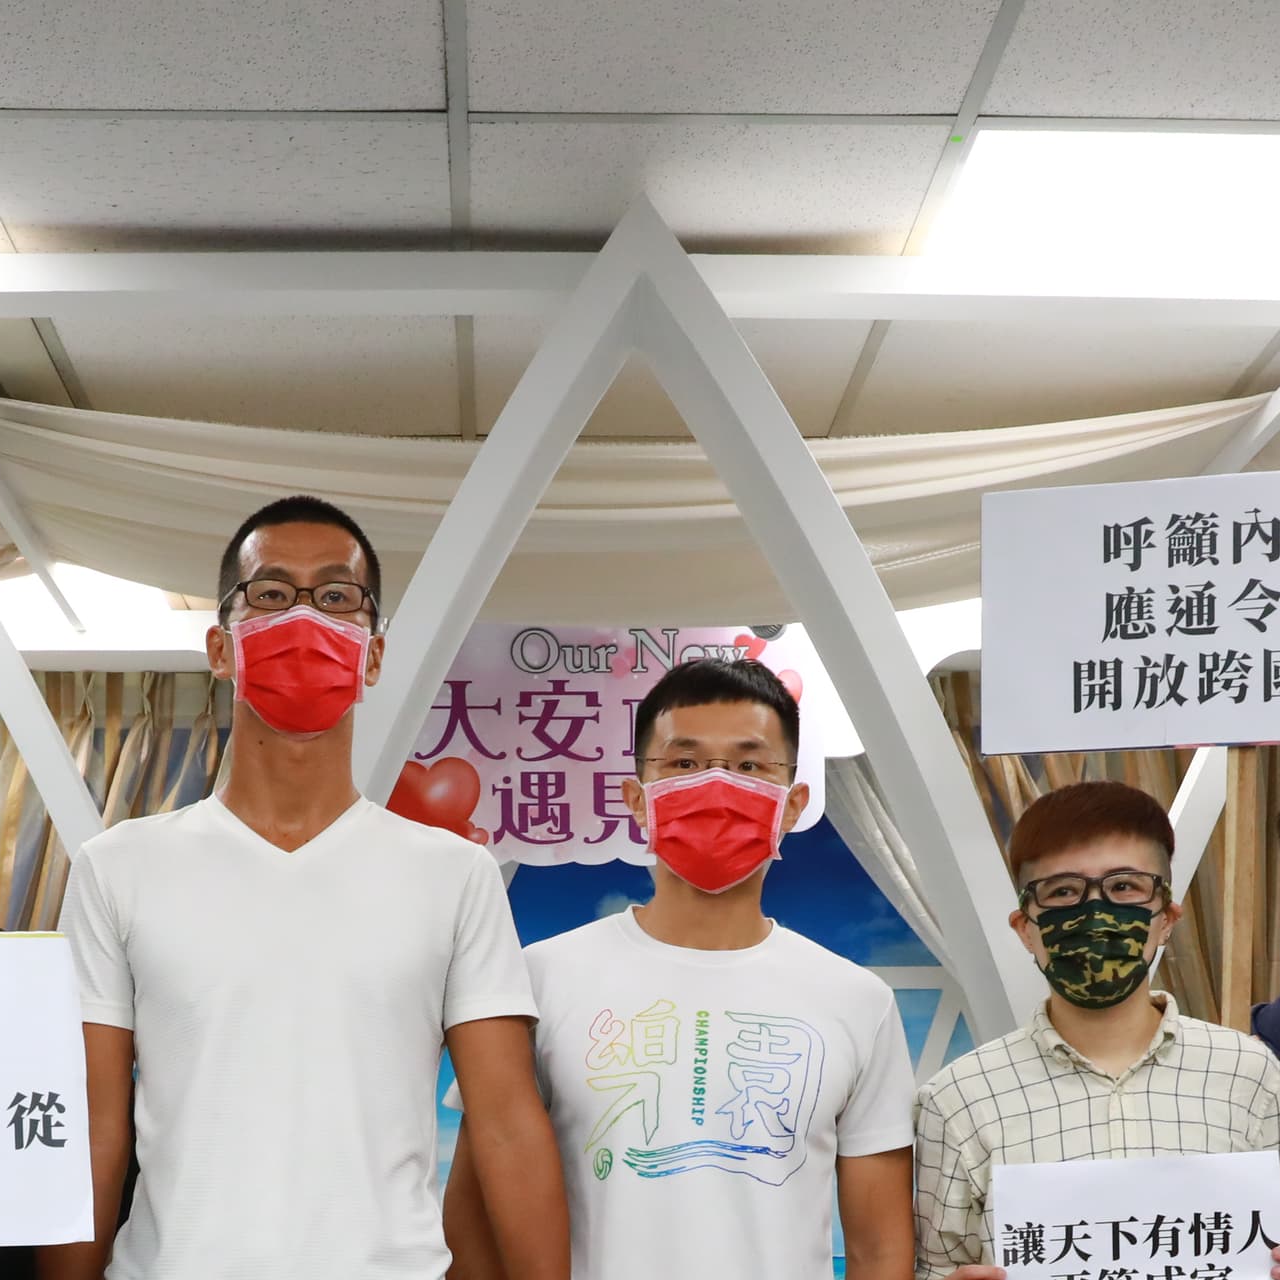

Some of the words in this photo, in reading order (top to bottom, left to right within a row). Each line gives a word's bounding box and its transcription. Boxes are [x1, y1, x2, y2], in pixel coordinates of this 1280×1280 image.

[511, 627, 617, 674] Our
[414, 679, 638, 763] 大安
[691, 1010, 710, 1126] CHAMPIONSHIP
